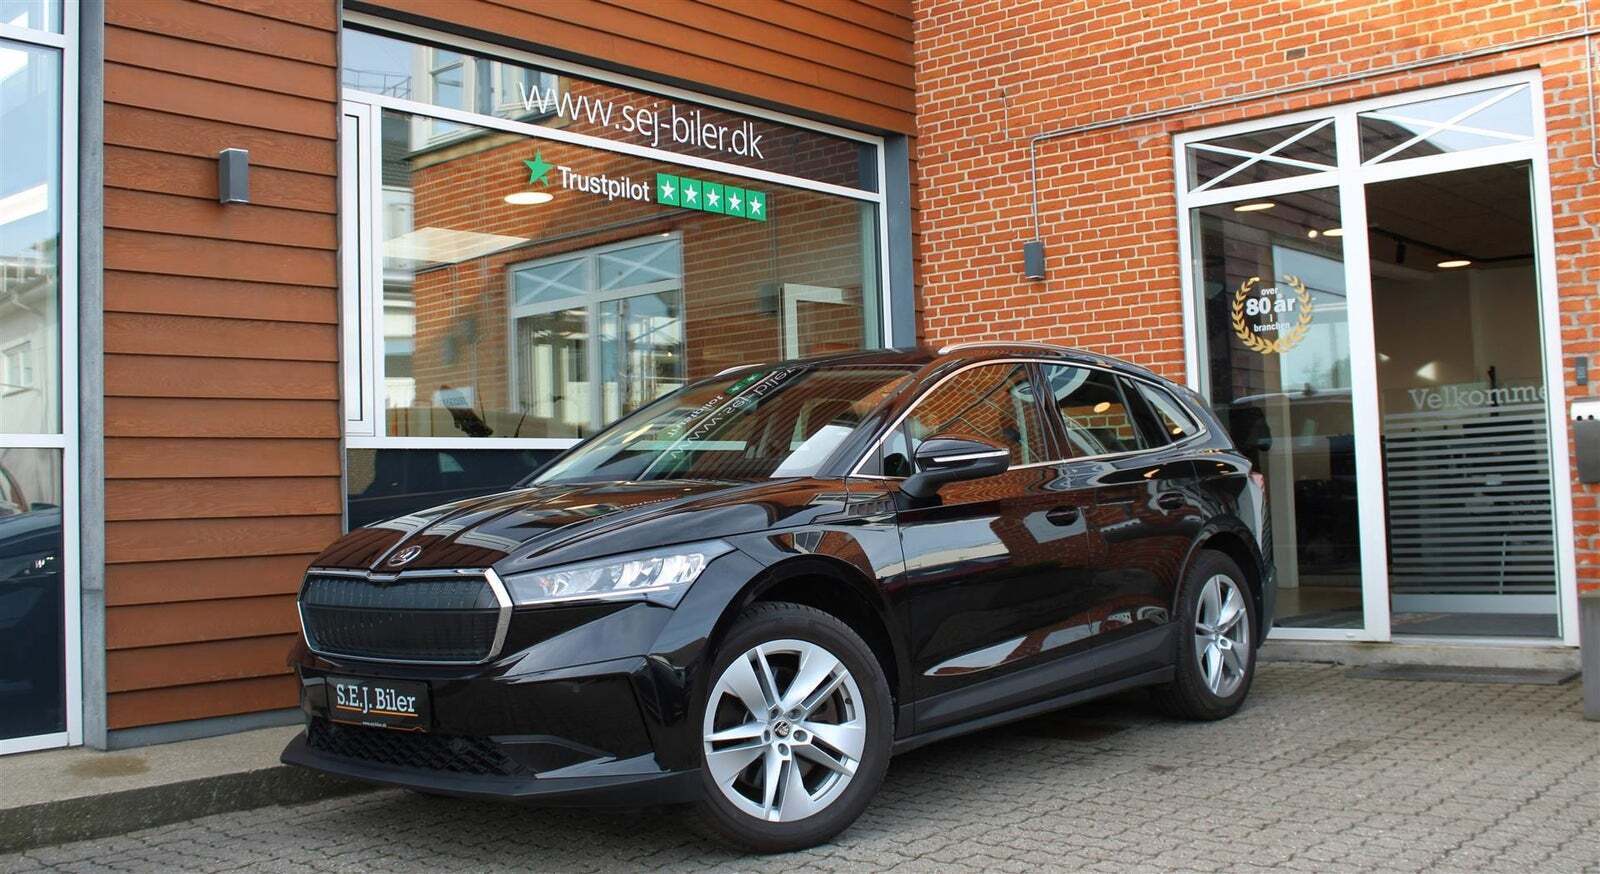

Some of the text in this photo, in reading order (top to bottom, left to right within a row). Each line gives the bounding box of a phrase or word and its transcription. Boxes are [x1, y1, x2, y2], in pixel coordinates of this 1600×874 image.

[519, 81, 764, 159] www.sej-biler.dk
[557, 165, 650, 202] Trustpilot
[1246, 293, 1295, 316] 80 år
[1261, 287, 1278, 296] over
[1253, 322, 1290, 332] branchen
[336, 683, 416, 714] S.E.J. Biler
